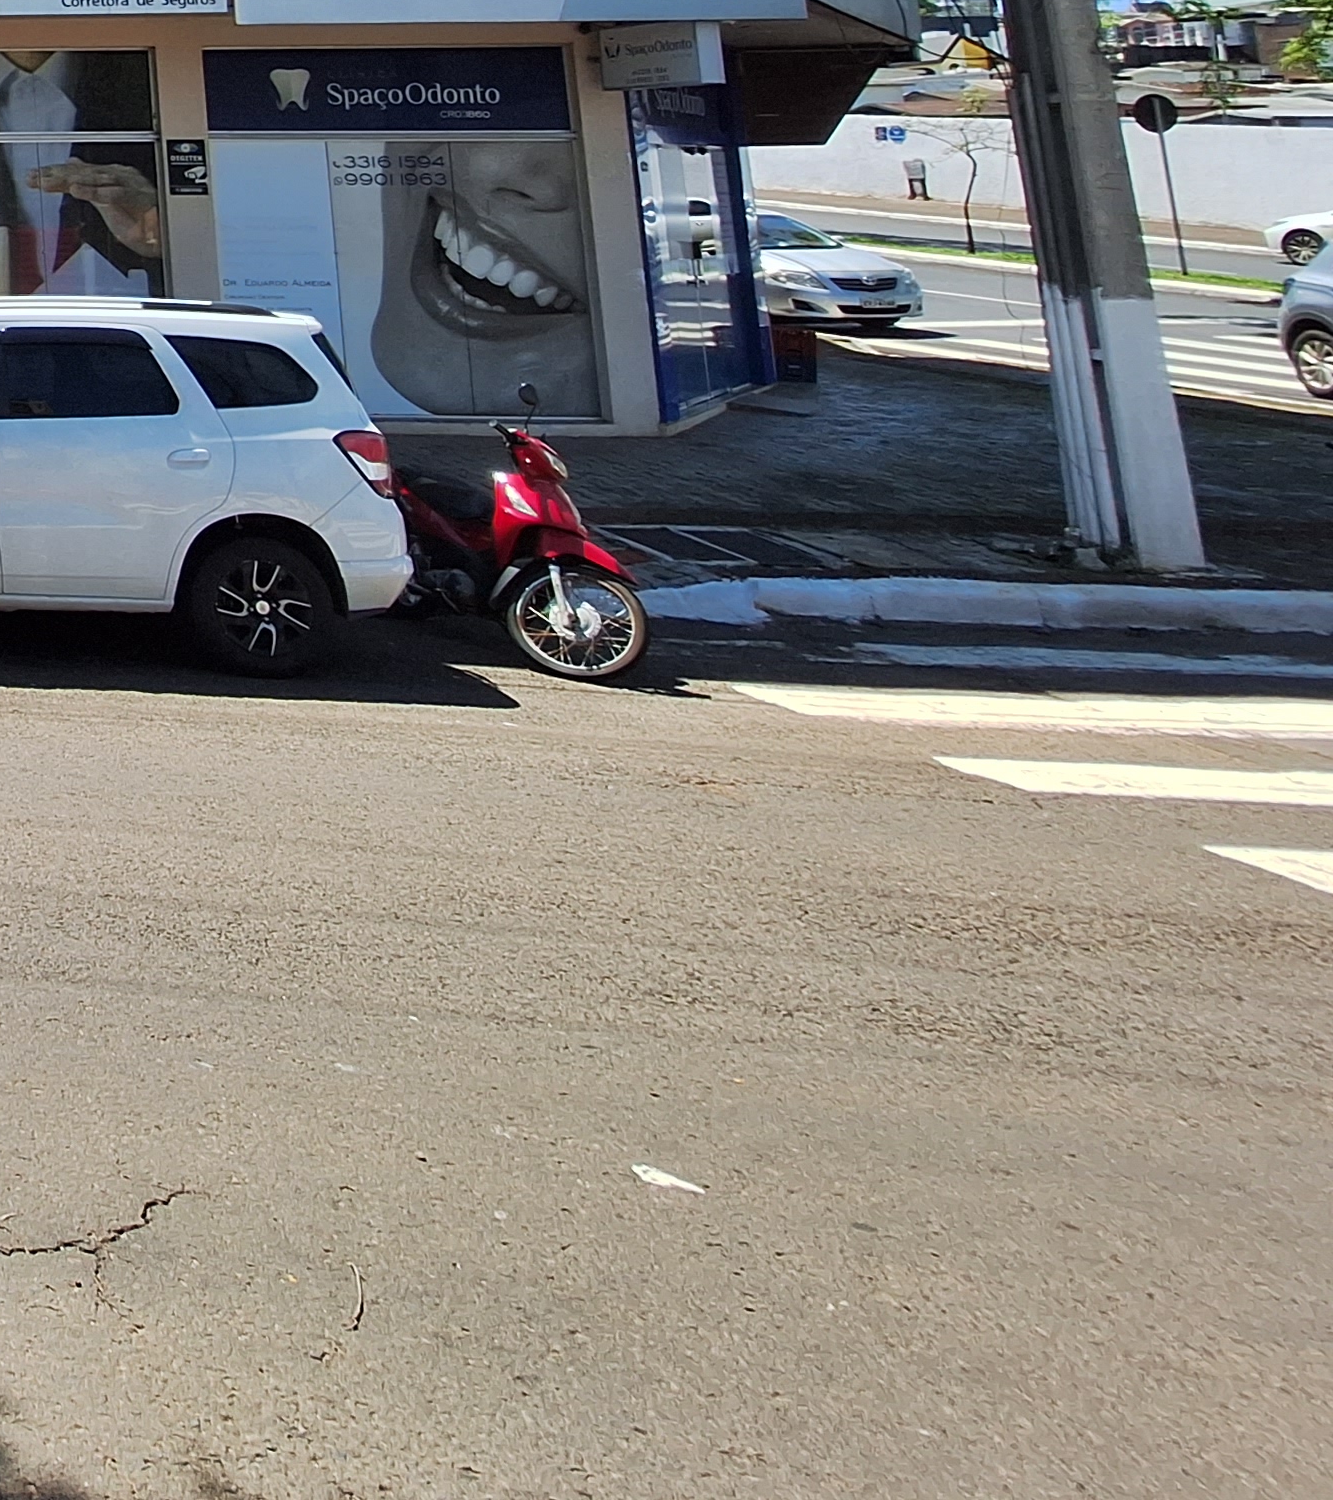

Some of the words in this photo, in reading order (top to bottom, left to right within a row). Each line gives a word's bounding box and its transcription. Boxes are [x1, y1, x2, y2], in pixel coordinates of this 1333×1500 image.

[326, 82, 500, 110] SpaçoOdonto
[343, 155, 391, 168] 3316
[399, 155, 445, 168] 1594
[344, 173, 393, 186] 9901
[400, 173, 447, 186] 1963
